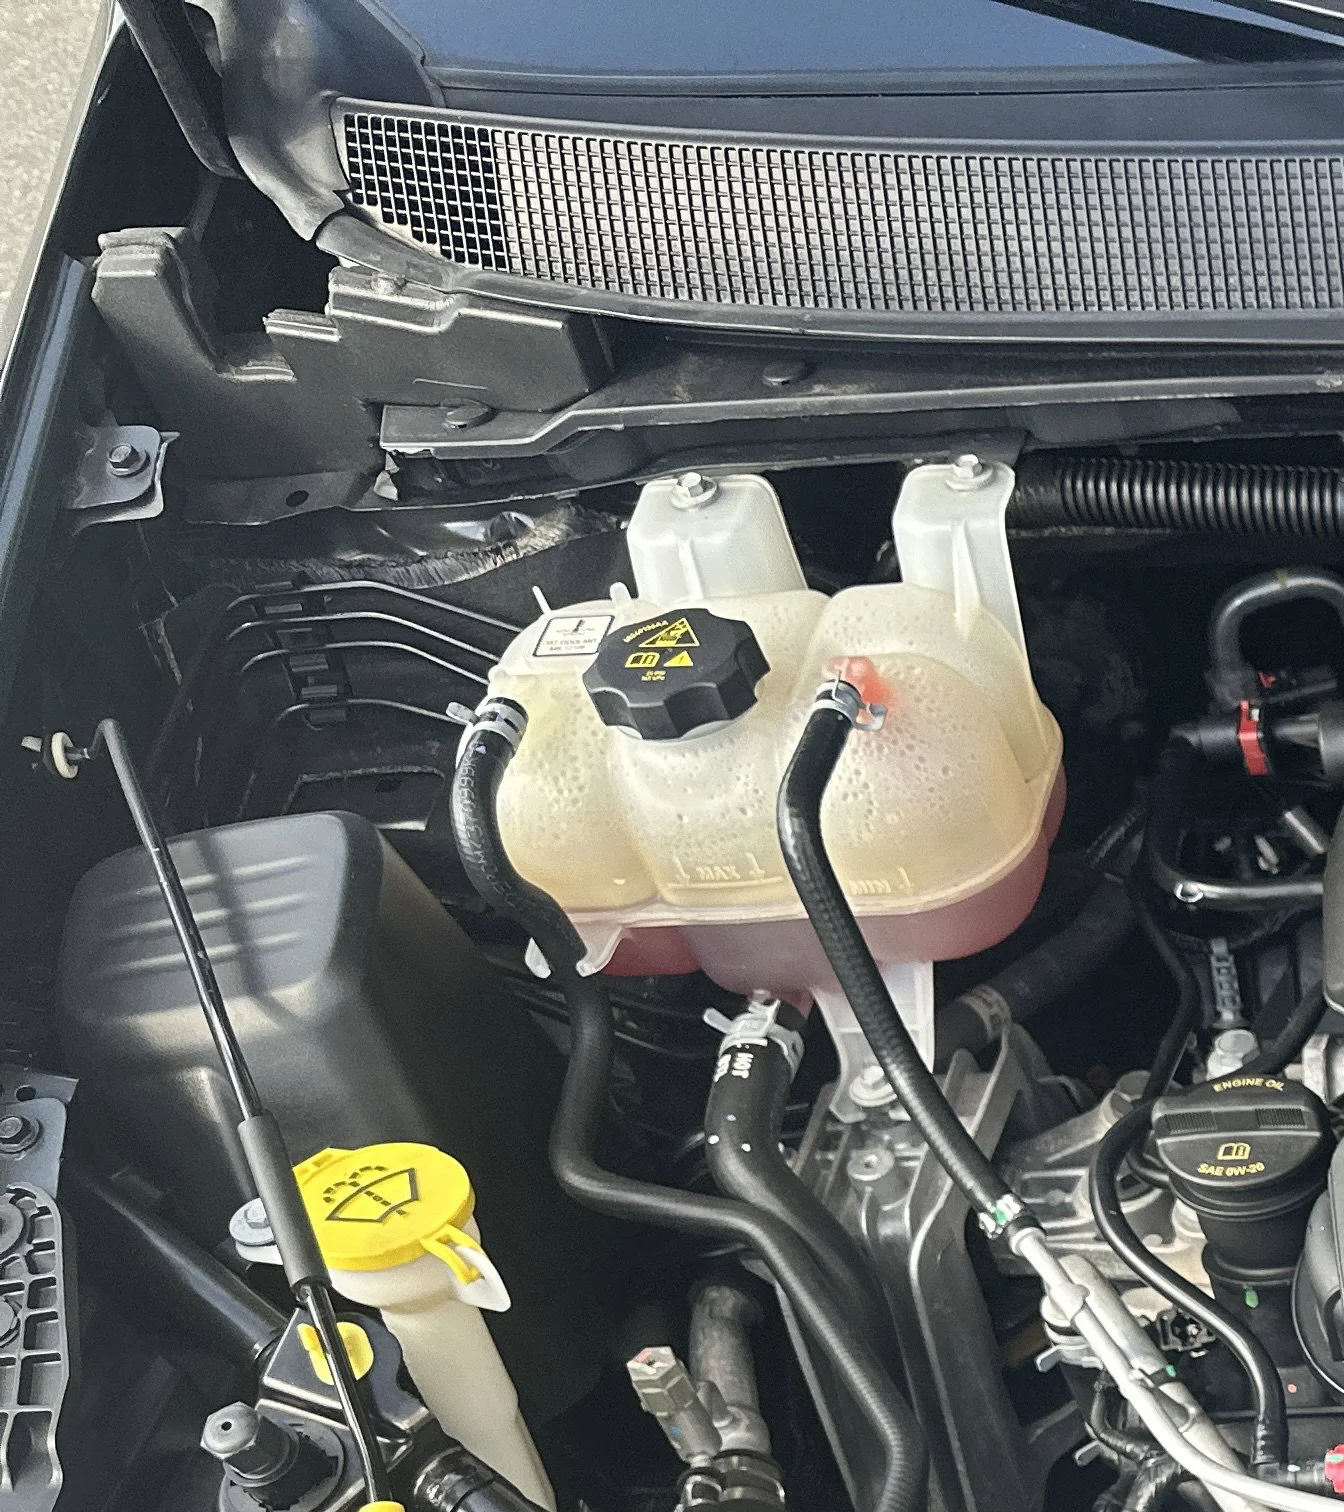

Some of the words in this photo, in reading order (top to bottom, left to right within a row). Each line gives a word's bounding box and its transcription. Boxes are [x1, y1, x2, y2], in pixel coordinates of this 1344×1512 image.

[695, 865, 741, 881] MAX
[1212, 1077, 1264, 1093] ENGINE
[1265, 1079, 1285, 1092] OIL
[1197, 1163, 1224, 1176] SAE
[1225, 1162, 1265, 1177] 0W-20
